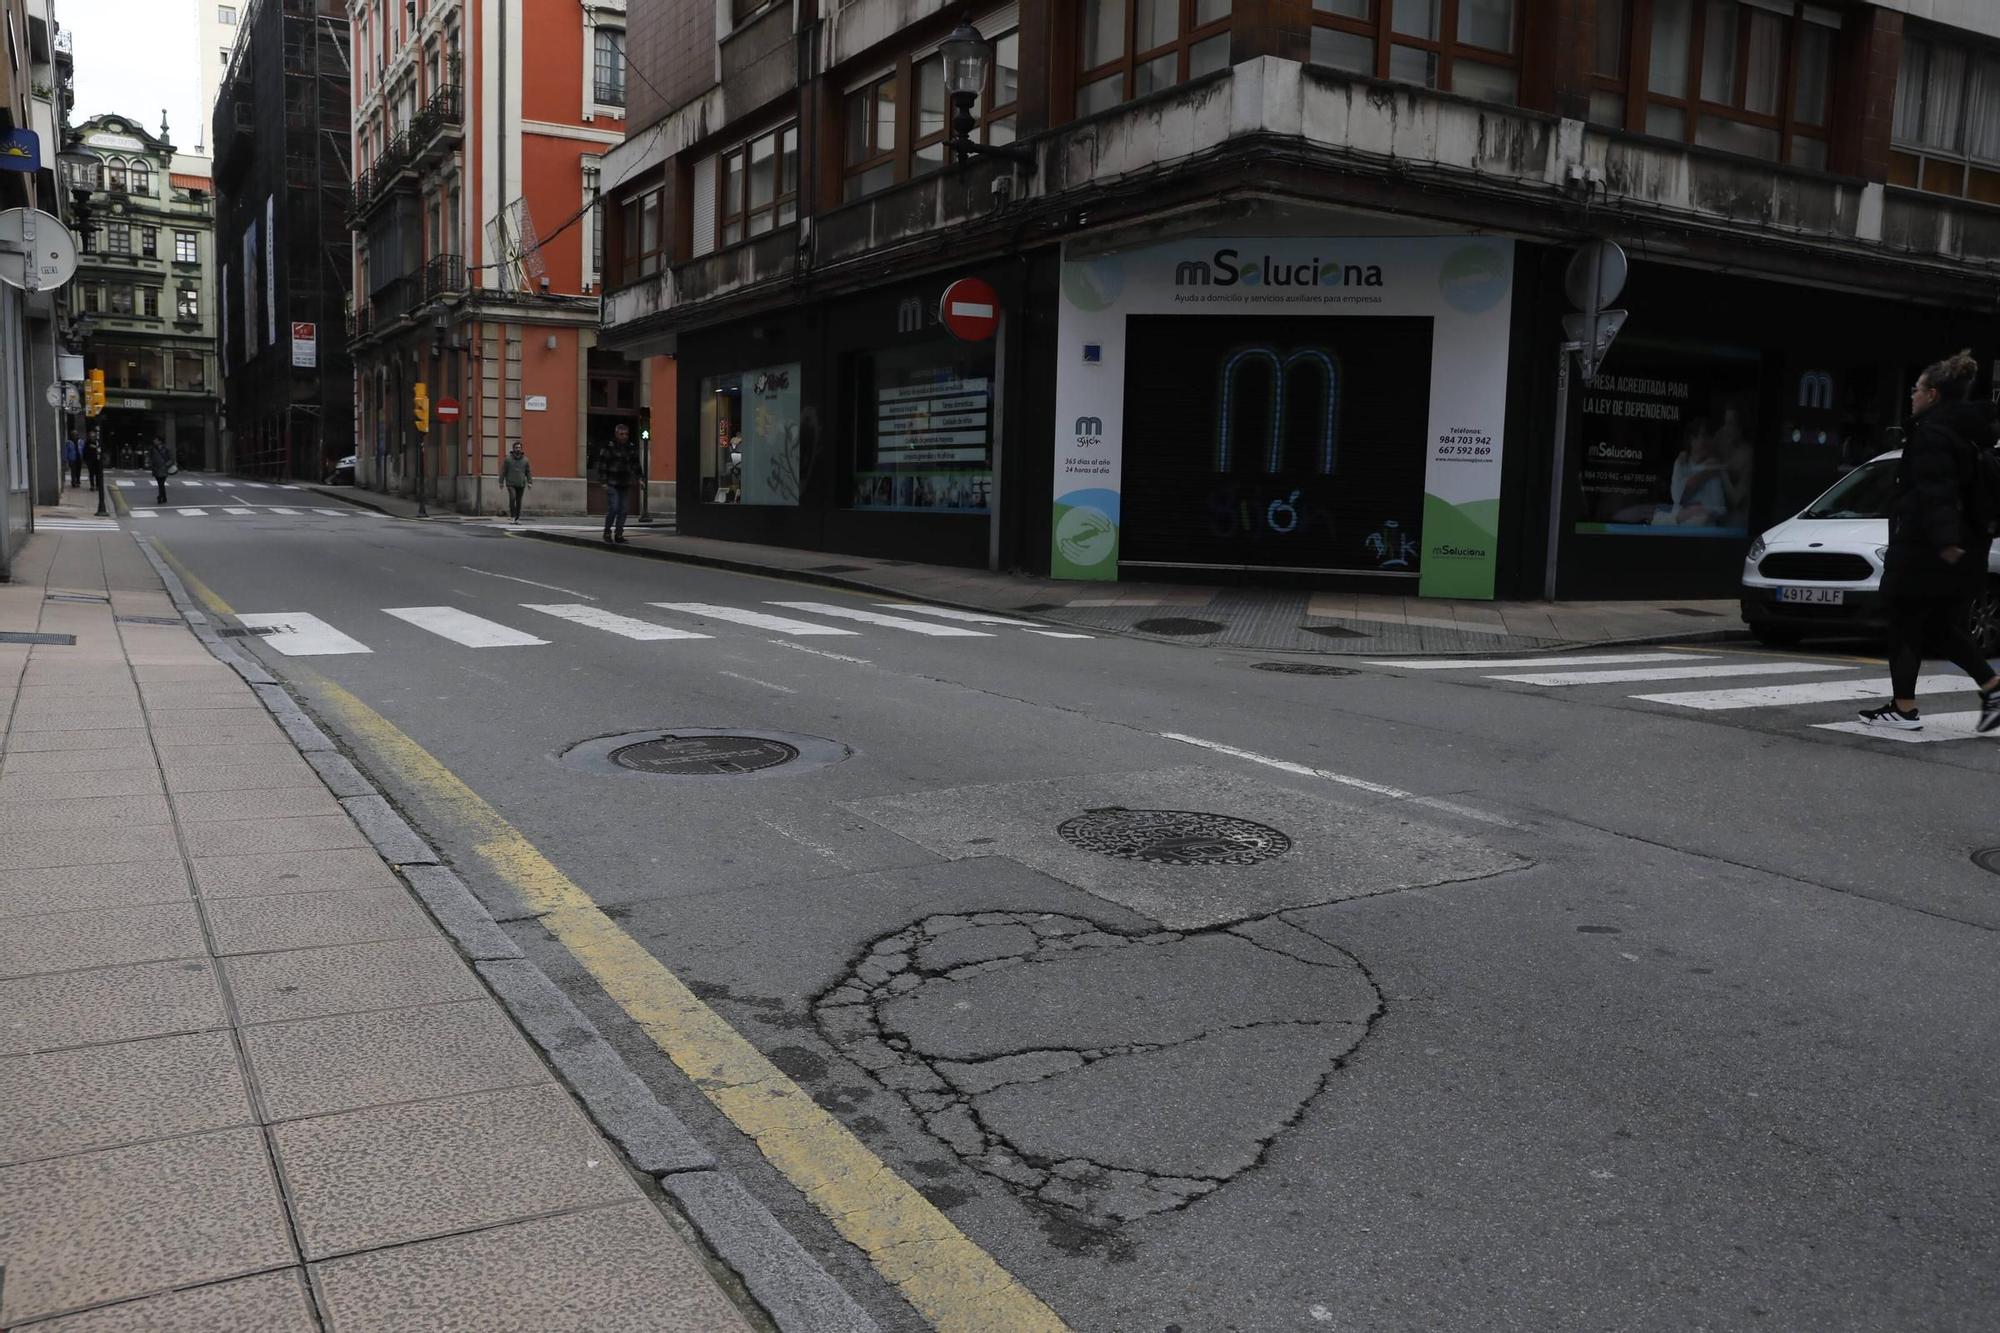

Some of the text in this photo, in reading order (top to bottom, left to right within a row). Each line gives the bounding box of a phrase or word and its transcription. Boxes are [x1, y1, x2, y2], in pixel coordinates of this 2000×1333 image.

[1175, 248, 1383, 287] mSoluciona
[1174, 294, 1199, 304] Ayuda
[1207, 294, 1242, 303] domicilio
[1250, 294, 1284, 303] servicios
[1285, 294, 1322, 303] auxiliares
[1323, 296, 1341, 305] para
[1342, 296, 1382, 305] empresas
[1616, 376, 1666, 396] ACREDITADA
[1667, 380, 1689, 399] PARA
[1583, 398, 1680, 421] LA LEY DE DEPENDENCIA
[1439, 436, 1491, 445] 984 703 942
[1438, 446, 1491, 455] 667 592 869
[1588, 442, 1643, 460] mSoluciona
[1091, 458, 1098, 466] al
[1098, 458, 1111, 466] año
[1065, 466, 1073, 474] 24
[1074, 466, 1091, 474] horas
[1432, 545, 1486, 557] mSoluciona
[1783, 589, 1841, 602] 4912 JLF
